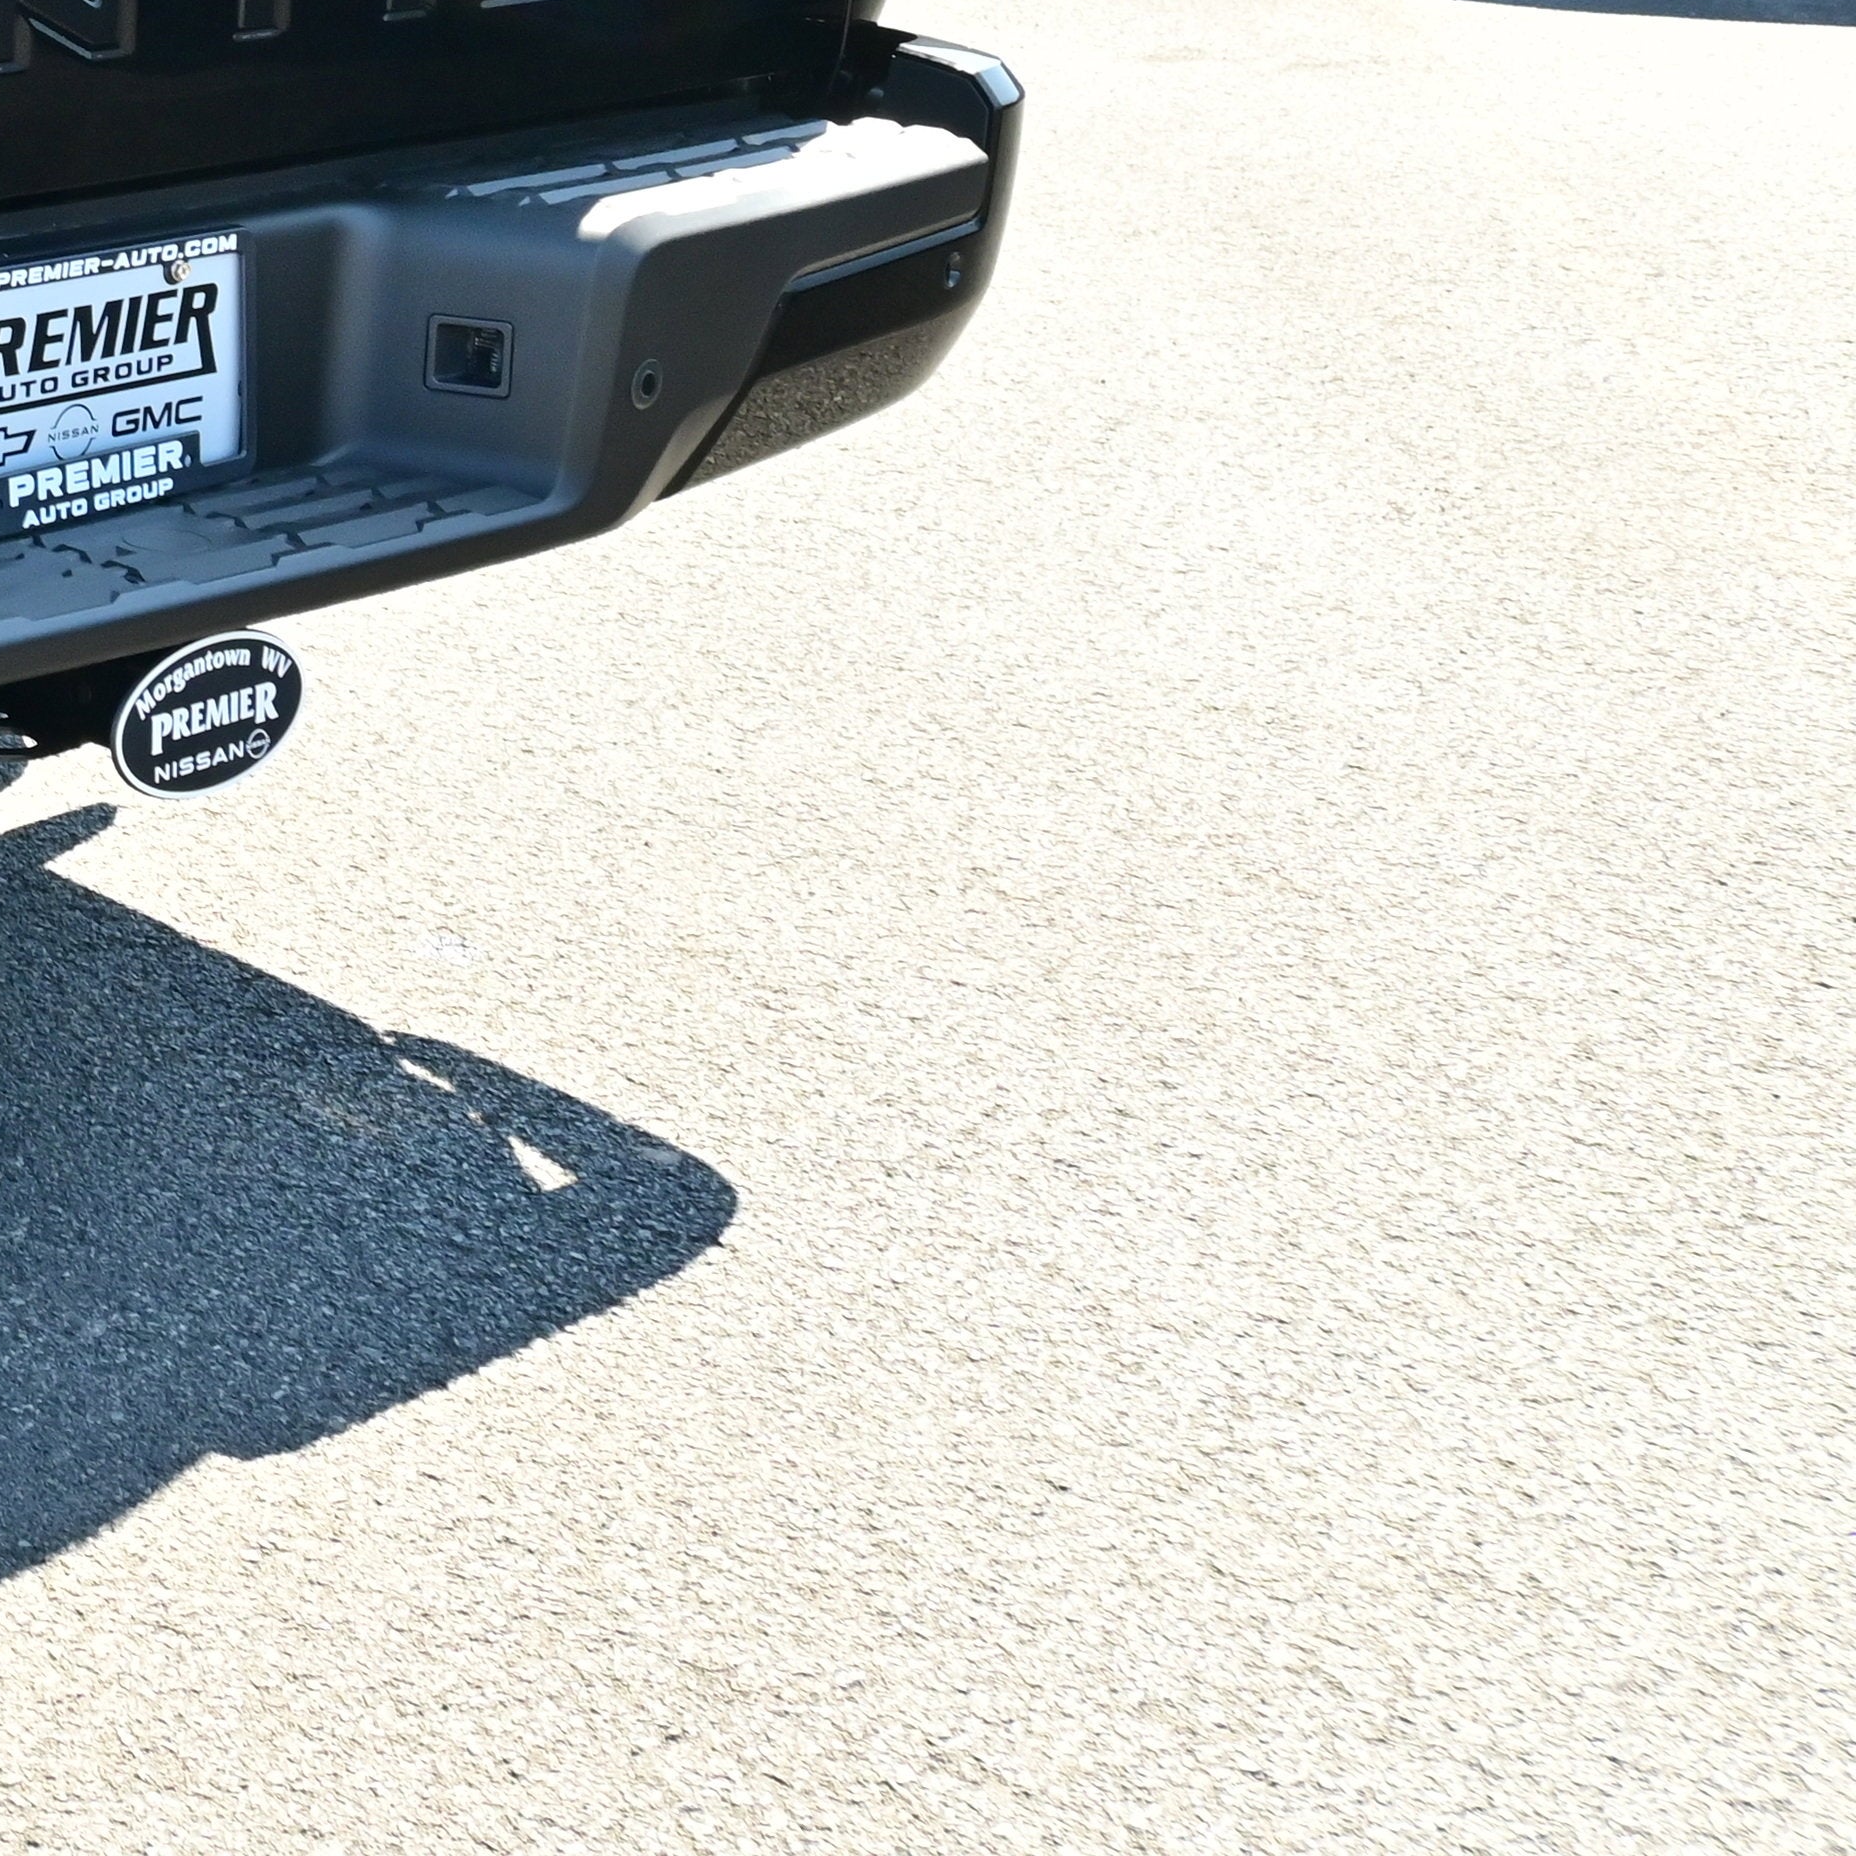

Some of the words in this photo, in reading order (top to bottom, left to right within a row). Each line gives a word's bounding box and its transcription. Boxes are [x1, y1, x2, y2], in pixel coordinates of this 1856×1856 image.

[71, 353, 175, 388] GROUP
[48, 424, 100, 443] NISSAN
[112, 395, 204, 437] GMC
[7, 440, 184, 508] PREMIER
[22, 497, 88, 529] AUTO
[93, 477, 174, 512] GROUP
[135, 647, 251, 721] Morgantown
[261, 645, 293, 679] WV
[150, 681, 280, 756] PREMIER
[154, 740, 245, 784] NISSAN
